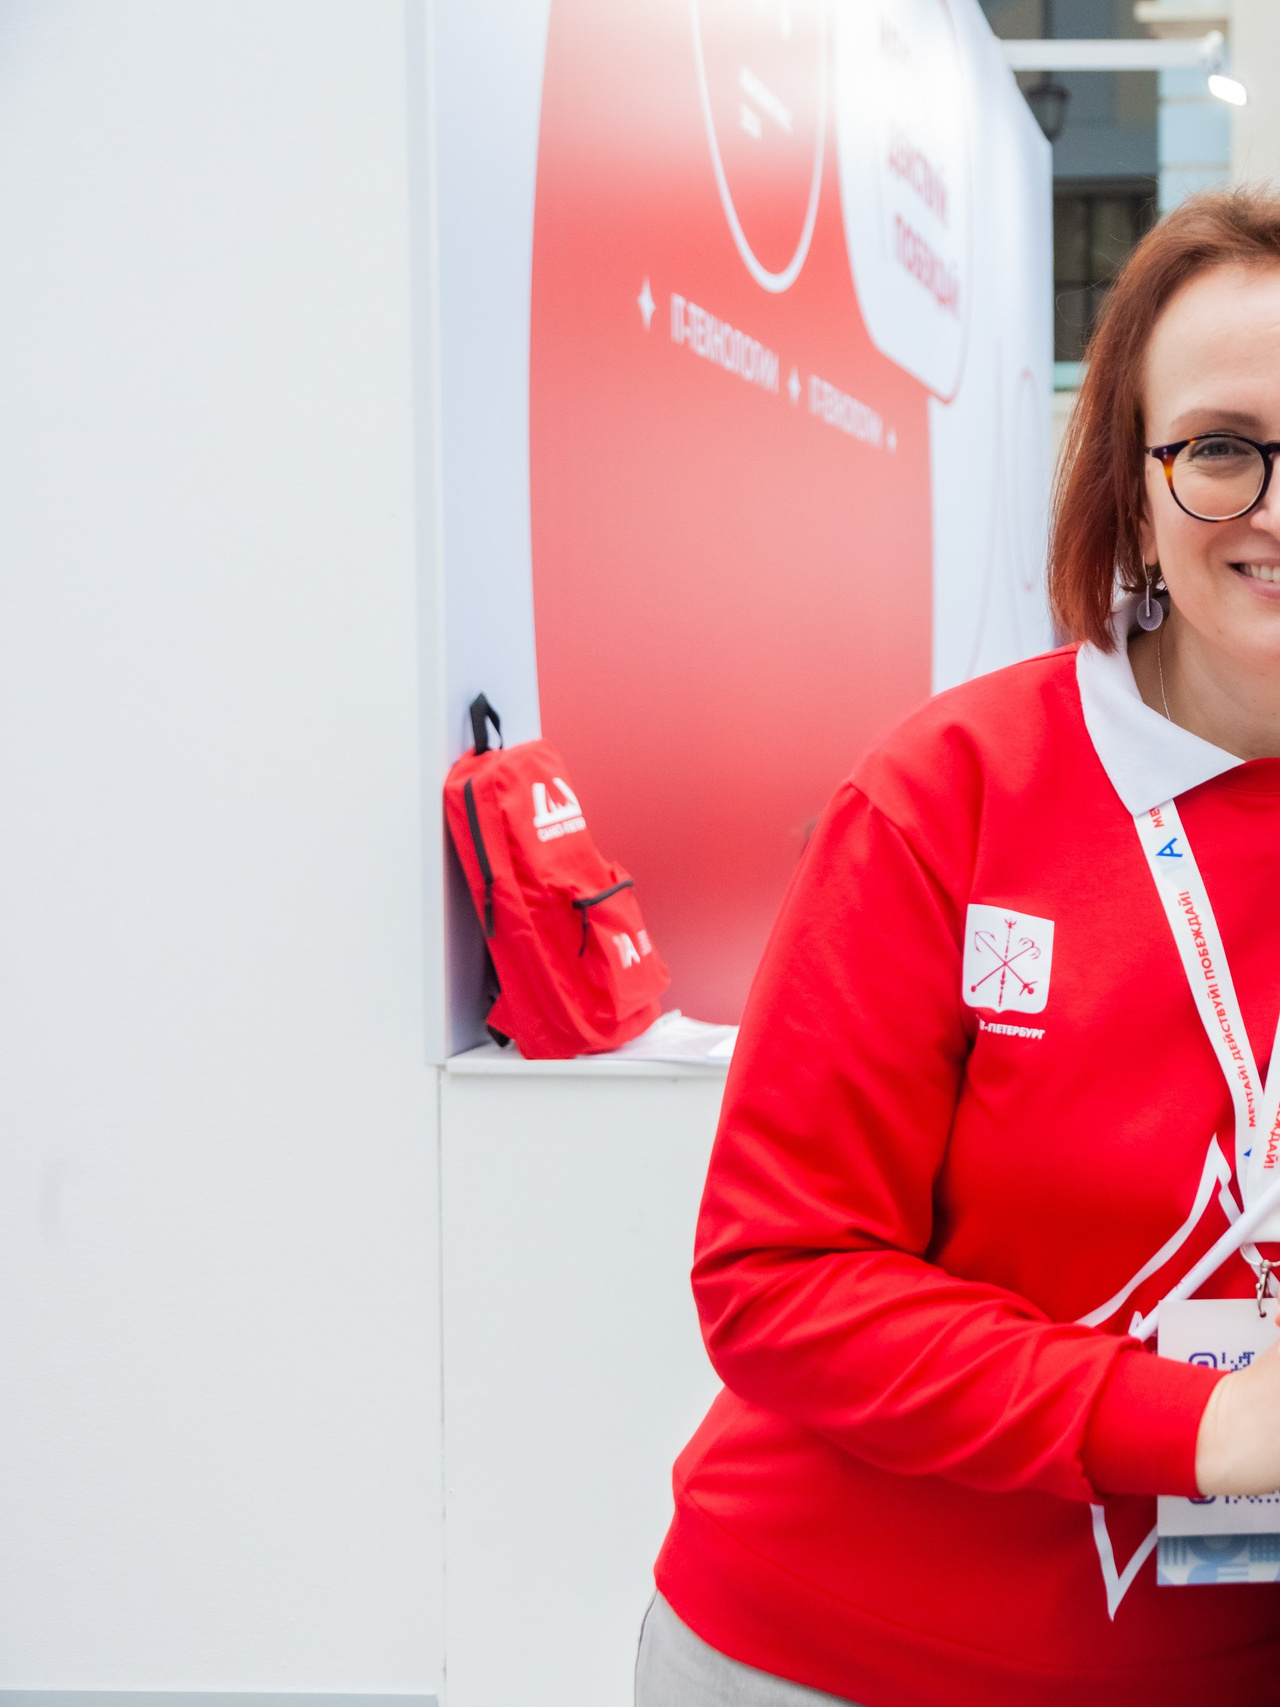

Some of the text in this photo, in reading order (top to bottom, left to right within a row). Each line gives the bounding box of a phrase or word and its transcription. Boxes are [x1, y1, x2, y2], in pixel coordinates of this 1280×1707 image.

[1177, 890, 1257, 1128] МЕЧТАЙ! ДЕЙСТВУЙ! ПОБЕЖДАЙ!
